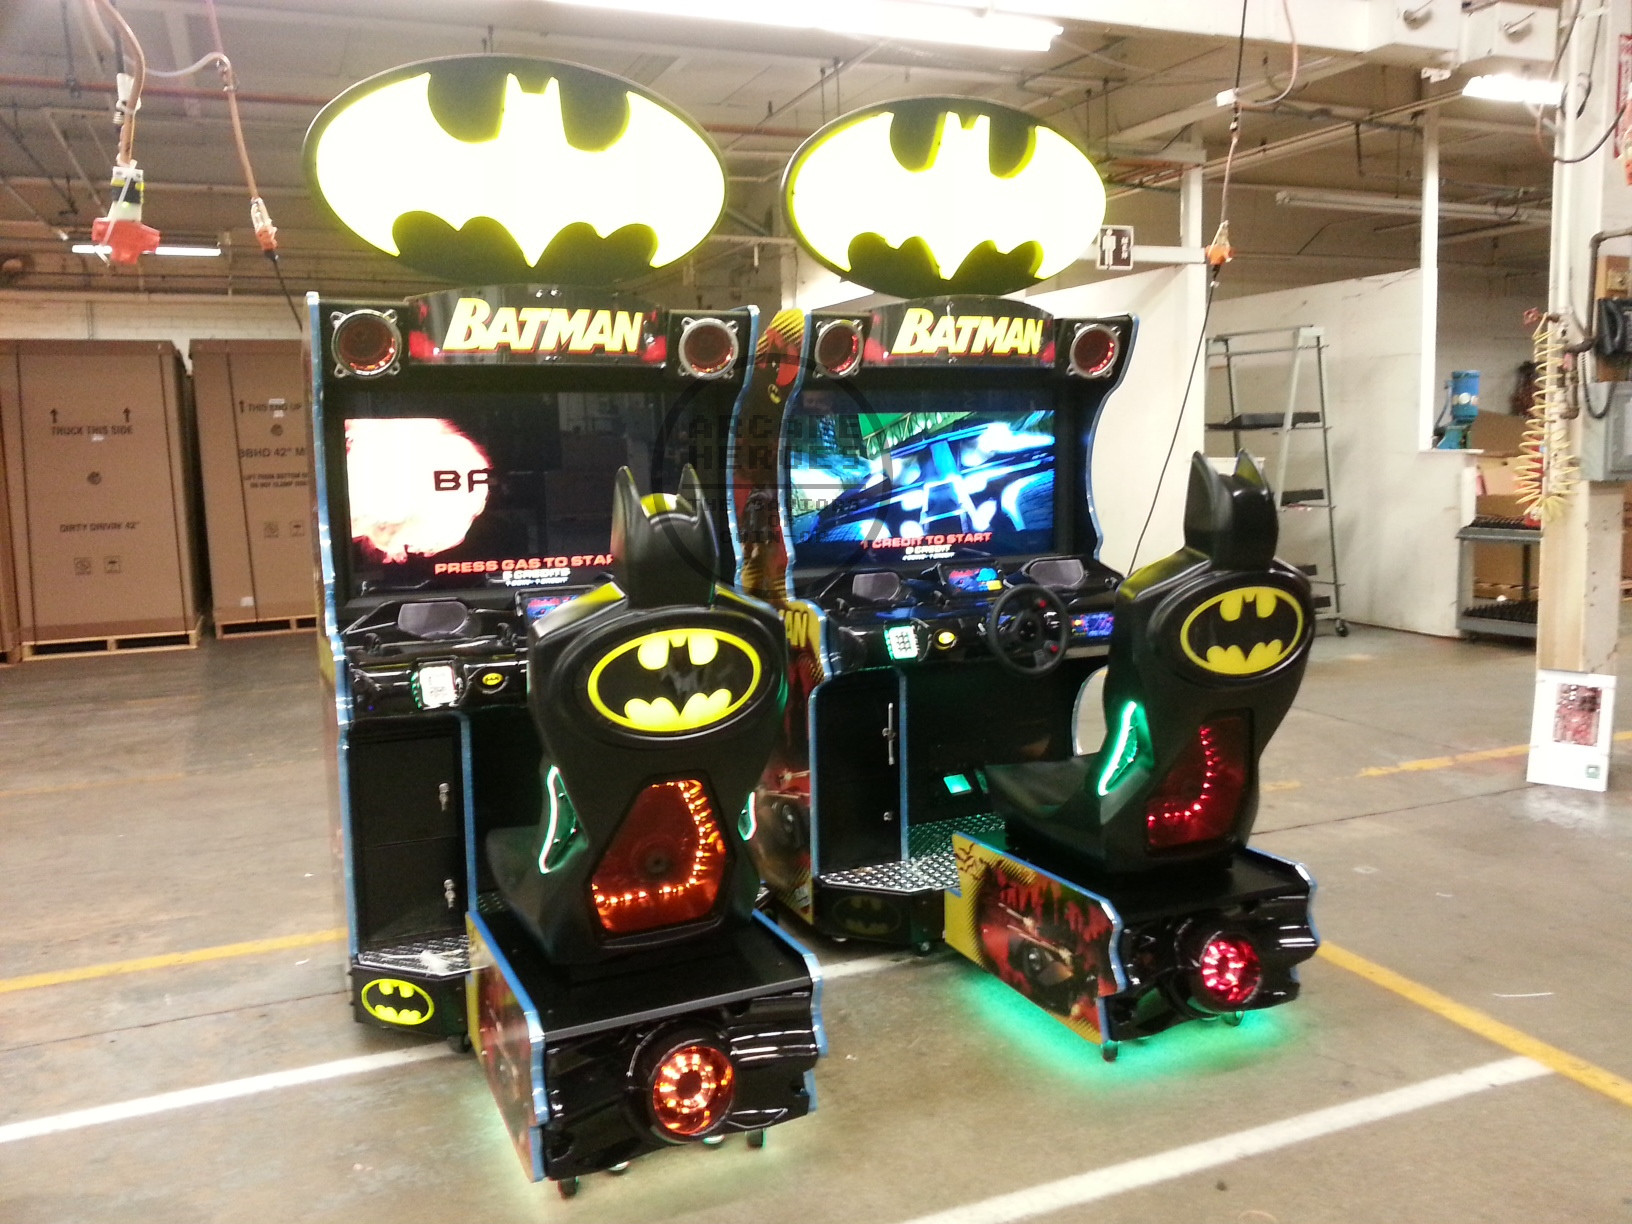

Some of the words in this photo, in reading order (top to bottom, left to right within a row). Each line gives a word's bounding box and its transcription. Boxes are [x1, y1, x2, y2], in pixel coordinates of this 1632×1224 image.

[443, 297, 643, 354] BATMAN
[891, 307, 1044, 357] BATMAN
[87, 425, 108, 435] THIS
[111, 424, 133, 435] SIDE
[872, 537, 924, 549] CREDIT
[925, 534, 945, 545] TO
[946, 532, 992, 544] START
[435, 560, 499, 575] PRESS
[502, 558, 541, 571] GAS
[543, 556, 568, 569] TO
